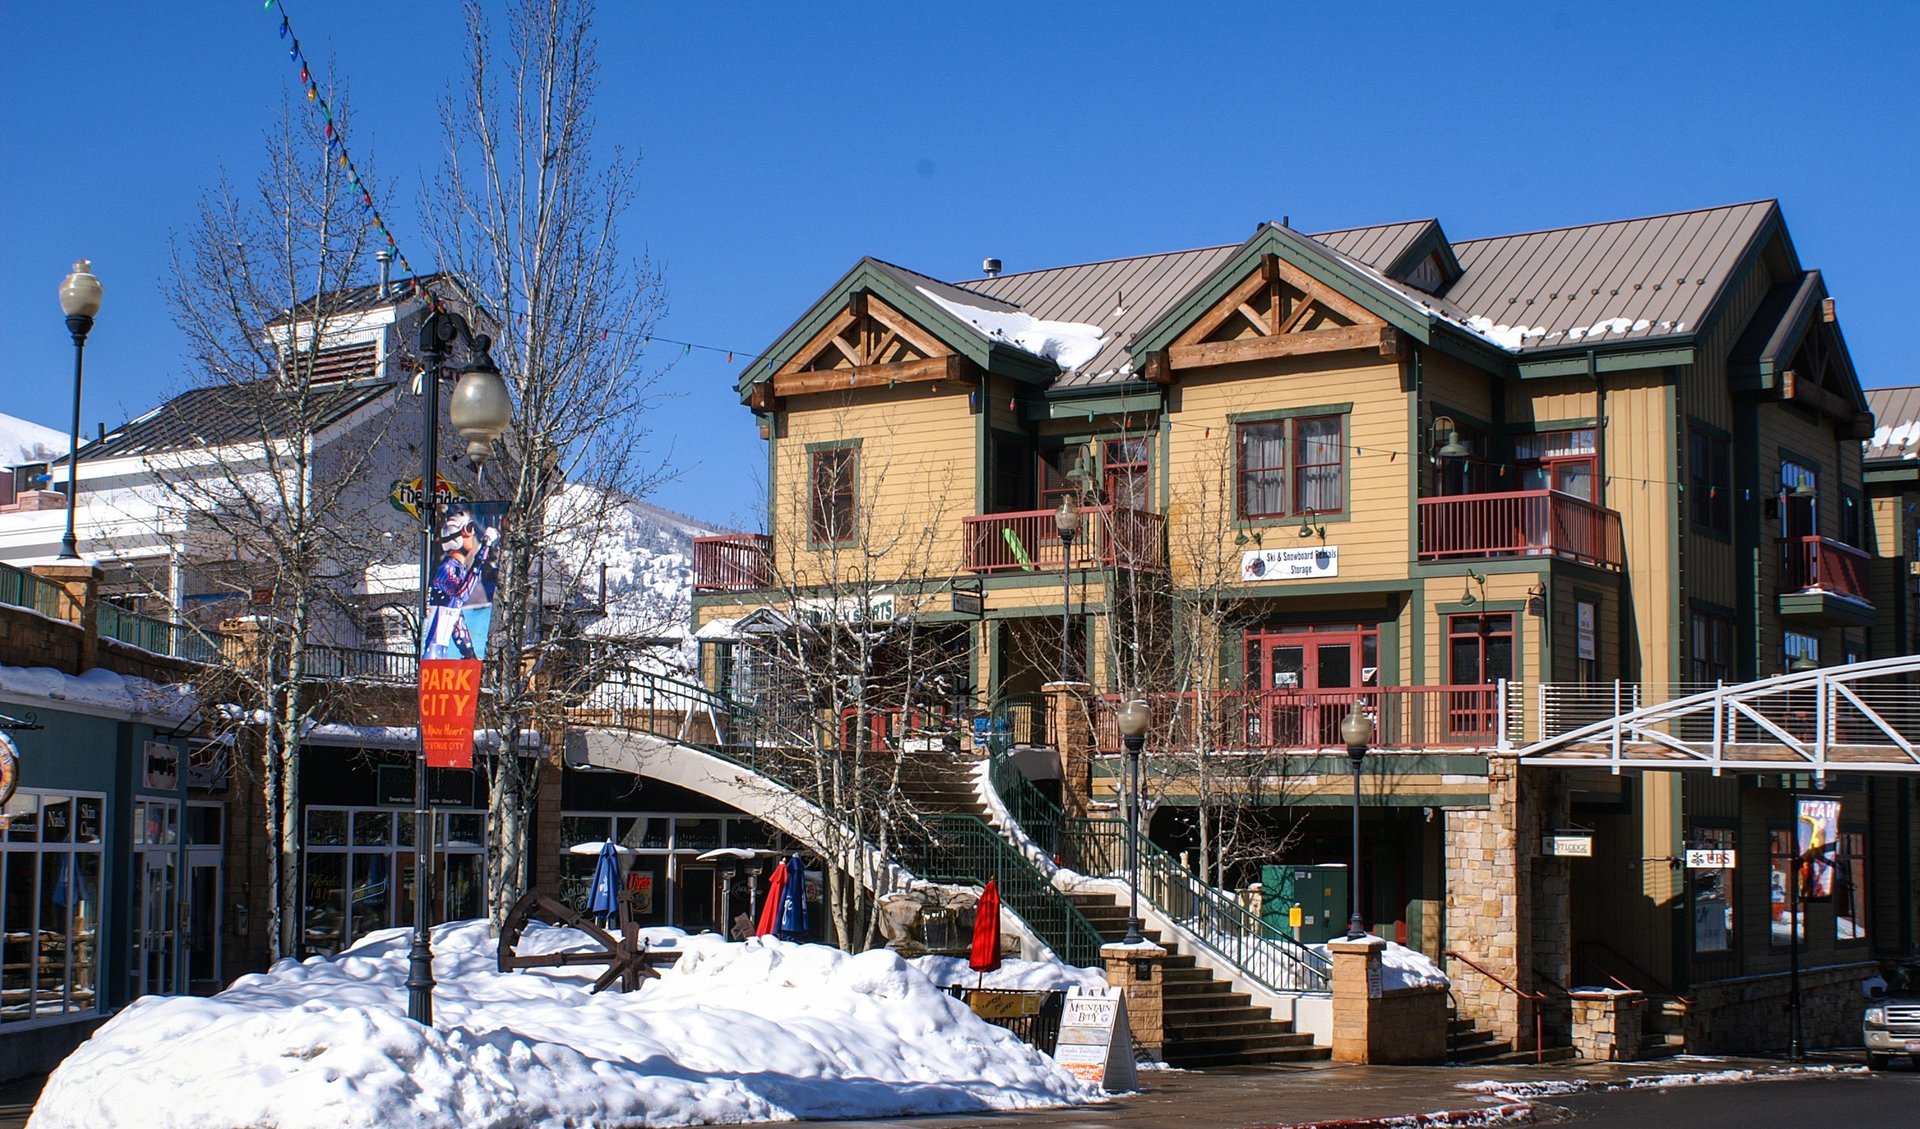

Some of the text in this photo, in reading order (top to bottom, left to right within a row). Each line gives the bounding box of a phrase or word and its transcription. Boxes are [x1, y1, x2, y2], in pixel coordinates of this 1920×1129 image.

[1266, 552, 1276, 562] Ski
[1277, 552, 1282, 562] &
[1283, 550, 1314, 561] Snowboard
[1290, 565, 1312, 575] Storage
[421, 668, 473, 691] PARK
[421, 693, 470, 717] CITY
[81, 803, 96, 819] Skin
[48, 810, 66, 828] Nails
[1706, 853, 1730, 865] UBS
[1069, 1002, 1111, 1014] MOUNTAIN
[1078, 1012, 1100, 1022] BODY
